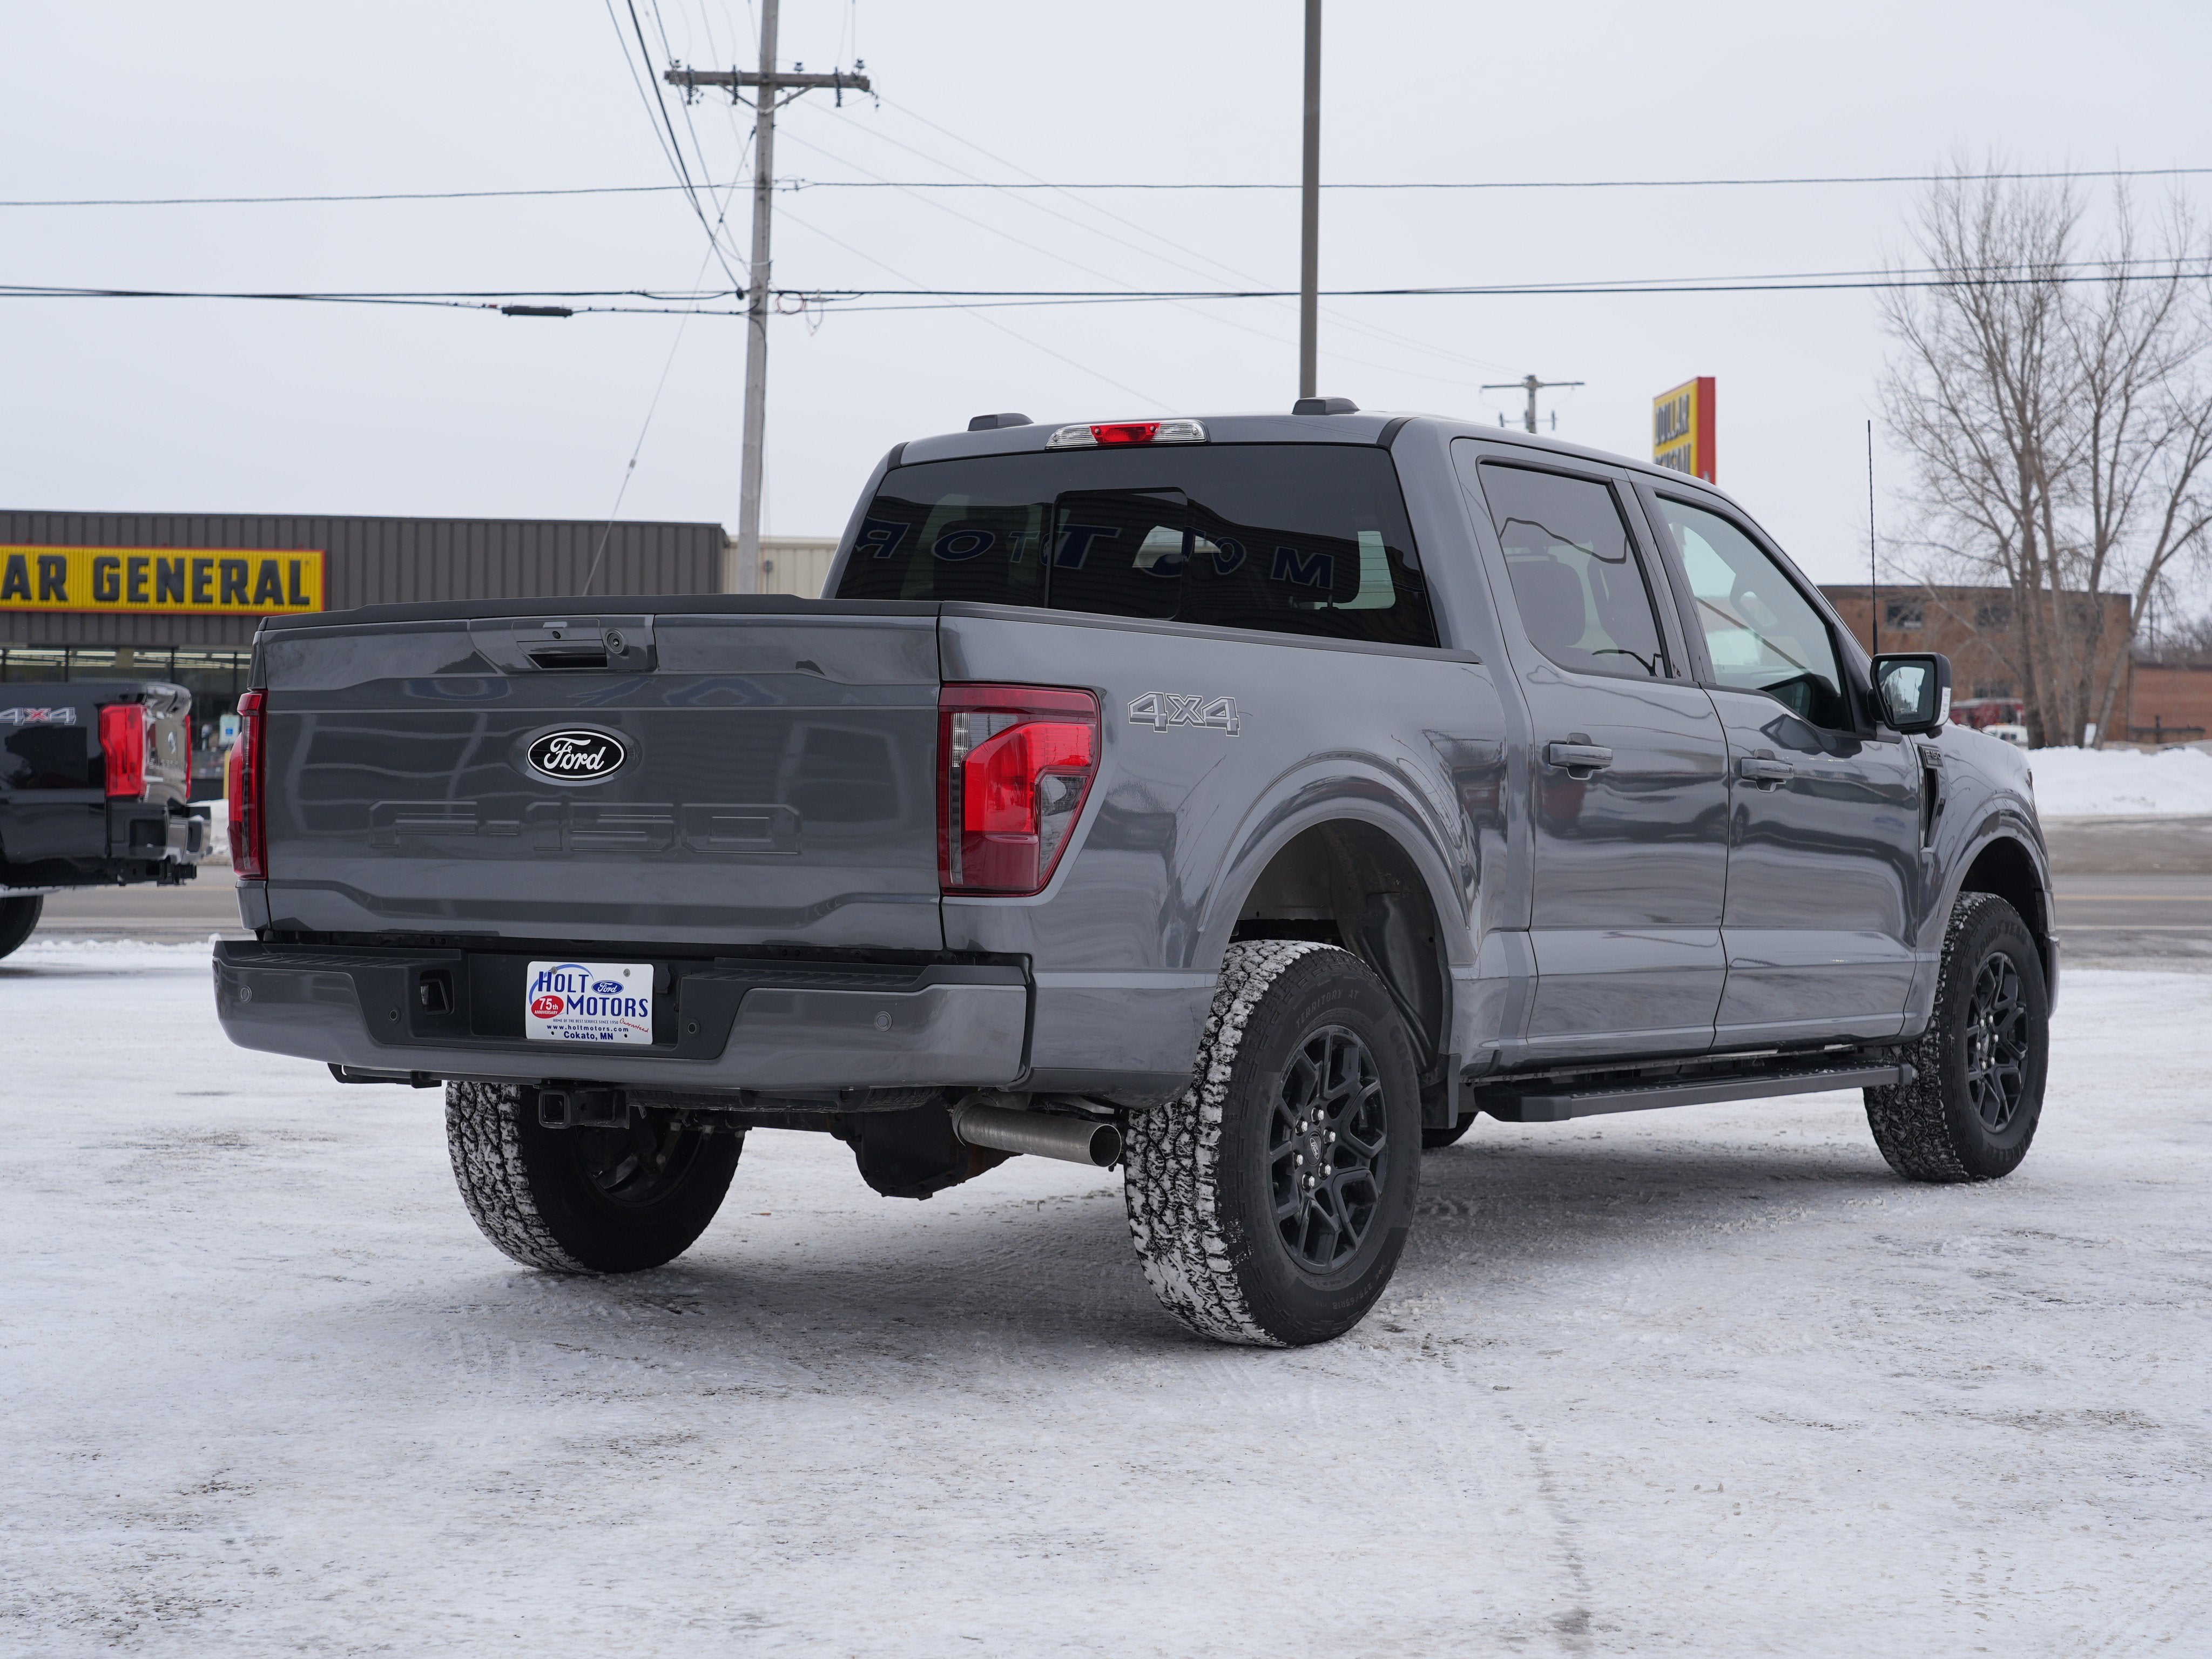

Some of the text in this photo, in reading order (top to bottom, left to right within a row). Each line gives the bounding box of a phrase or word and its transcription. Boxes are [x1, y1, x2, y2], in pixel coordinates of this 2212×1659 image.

[93, 556, 311, 606] GENERAL
[543, 736, 606, 771] Ford
[369, 800, 802, 855] F-150
[538, 971, 589, 993] HOLT
[597, 982, 617, 993] Ford
[539, 998, 558, 1010] 75th
[567, 994, 649, 1017] MOTORS
[1296, 988, 1360, 1028] TERRITORY AT
[547, 1024, 629, 1033] www.holtmotors.com
[564, 1031, 614, 1041] Cokato, MN
[619, 1018, 649, 1033] Guaranteed
